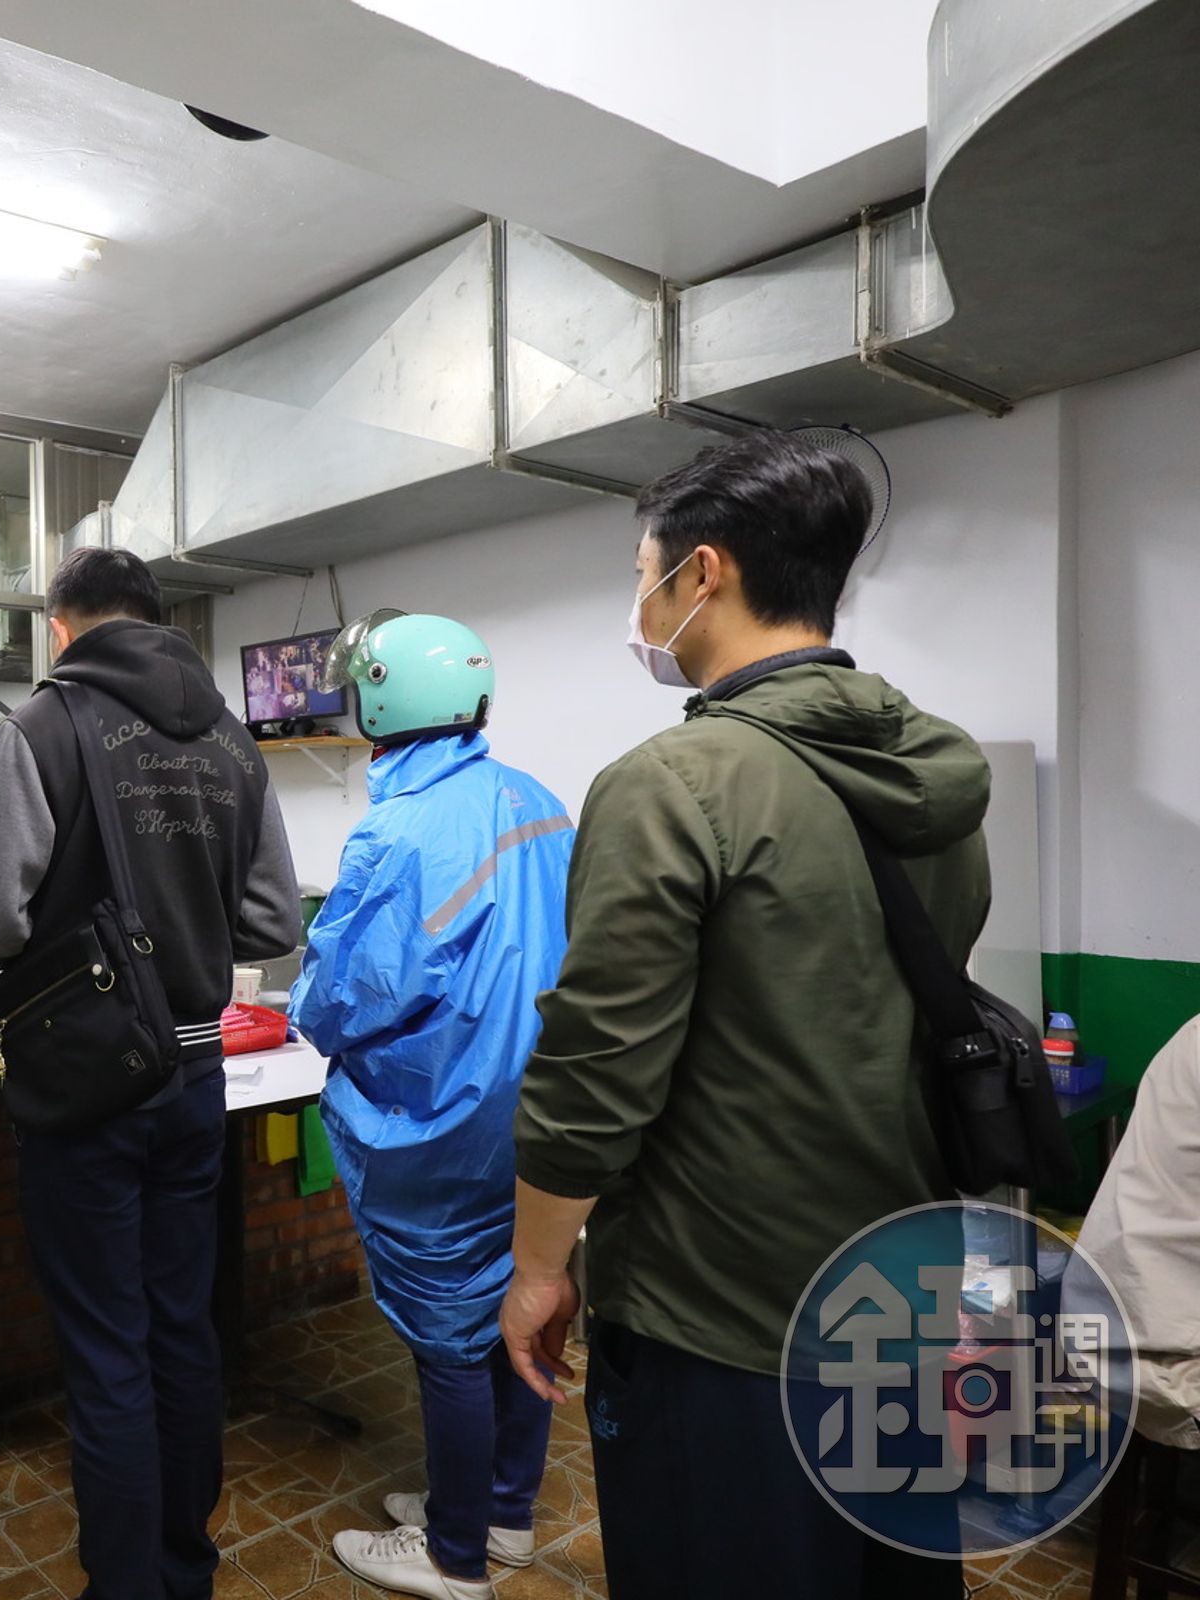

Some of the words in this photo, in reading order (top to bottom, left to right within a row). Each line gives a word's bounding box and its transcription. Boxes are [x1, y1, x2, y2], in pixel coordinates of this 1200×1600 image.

[99, 718, 151, 751] ace
[137, 753, 190, 771] About
[190, 756, 221, 777] The
